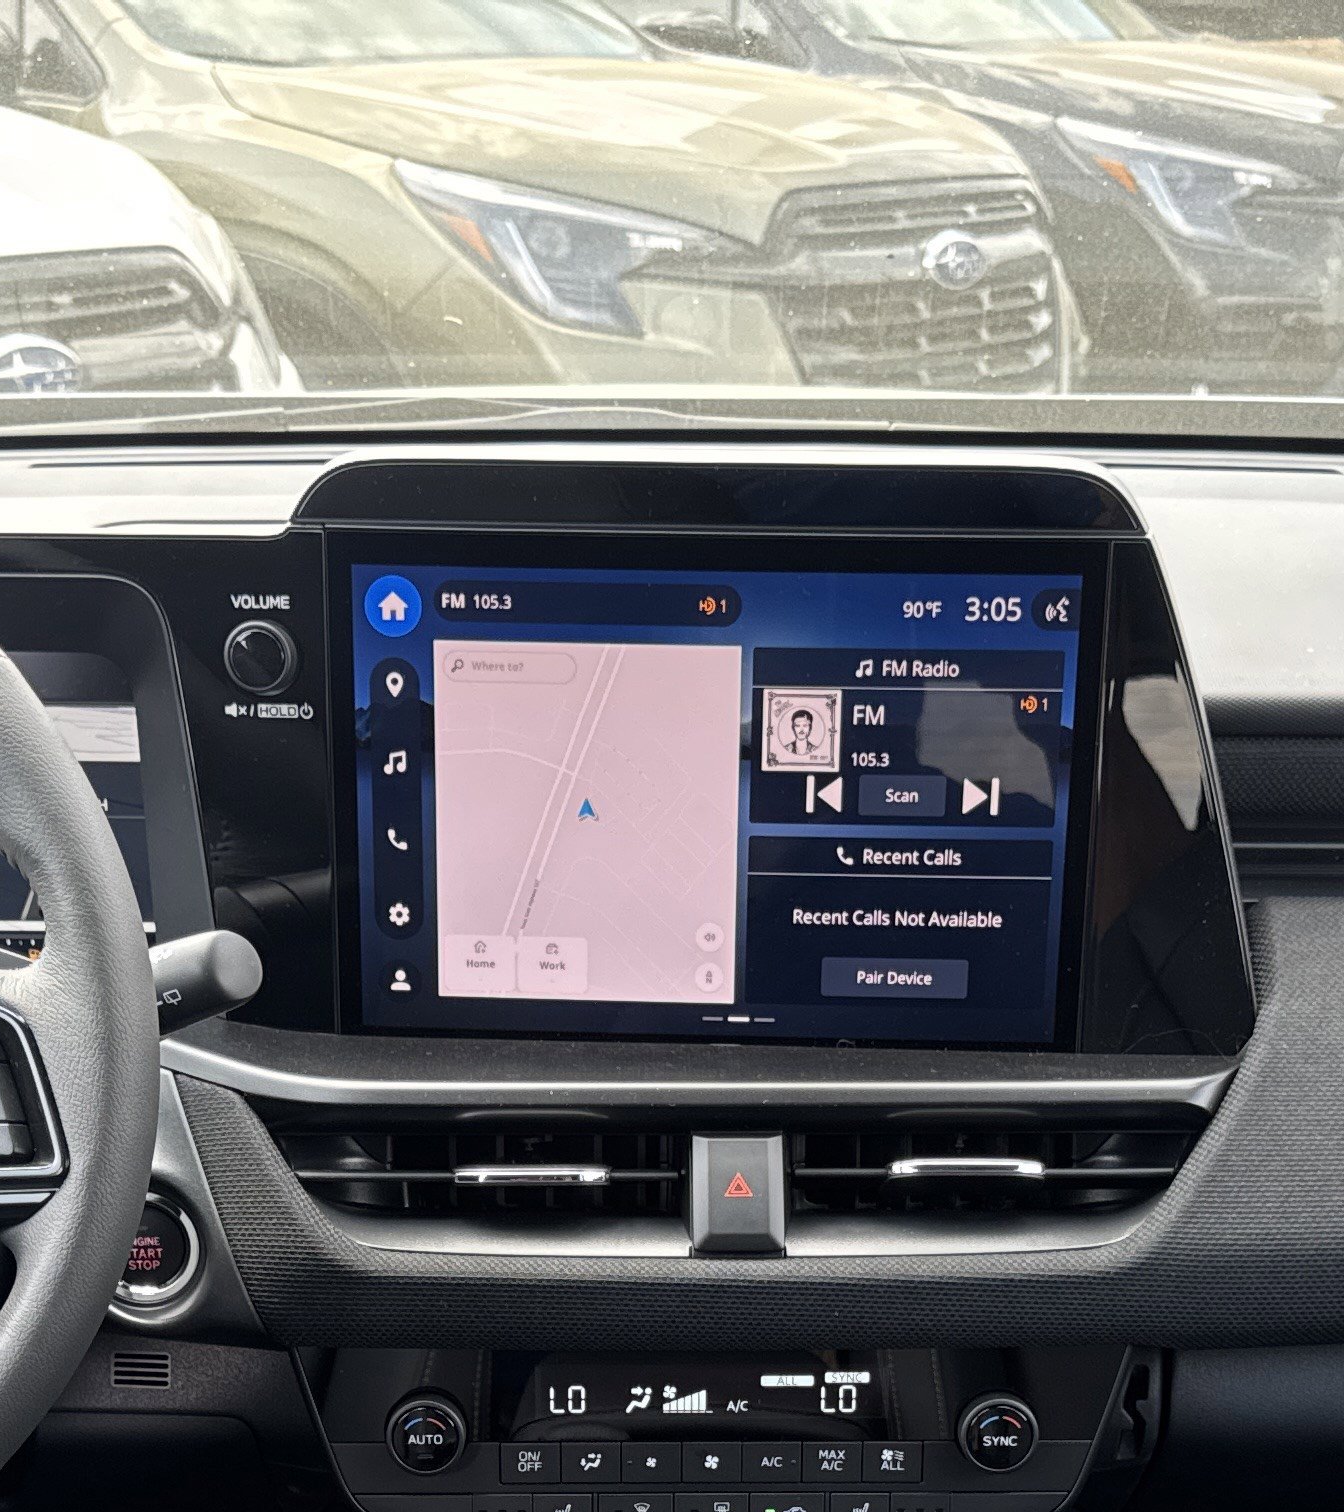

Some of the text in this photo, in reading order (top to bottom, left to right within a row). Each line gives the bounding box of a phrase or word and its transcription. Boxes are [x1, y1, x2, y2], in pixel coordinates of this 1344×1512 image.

[230, 594, 291, 610] VOLUME
[442, 593, 512, 611] FM 105.3
[965, 596, 1022, 622] 3:05
[471, 660, 524, 673] Where to?
[882, 660, 960, 678] FM Radio
[258, 705, 298, 717] HOLD
[852, 705, 886, 726] FM
[851, 752, 890, 768] 105.3
[885, 787, 919, 803] Scan
[863, 848, 962, 866] Recent Calls
[792, 908, 1003, 928] Recent Calls Not Available
[466, 958, 496, 970] Home
[539, 960, 566, 971] Work
[856, 970, 933, 986] Pair Device
[128, 1260, 160, 1271] STOP
[776, 1376, 798, 1386] ALL
[831, 1372, 863, 1384] SYNC
[726, 1400, 749, 1412] A/C
[408, 1434, 443, 1445] AUTO
[982, 1436, 1018, 1447] SYNC
[519, 1451, 541, 1462] ON/
[818, 1449, 846, 1460] MAX
[518, 1461, 543, 1472] OFF
[761, 1456, 783, 1468] A/C
[820, 1460, 844, 1471] A/C
[880, 1460, 905, 1471] ALL
